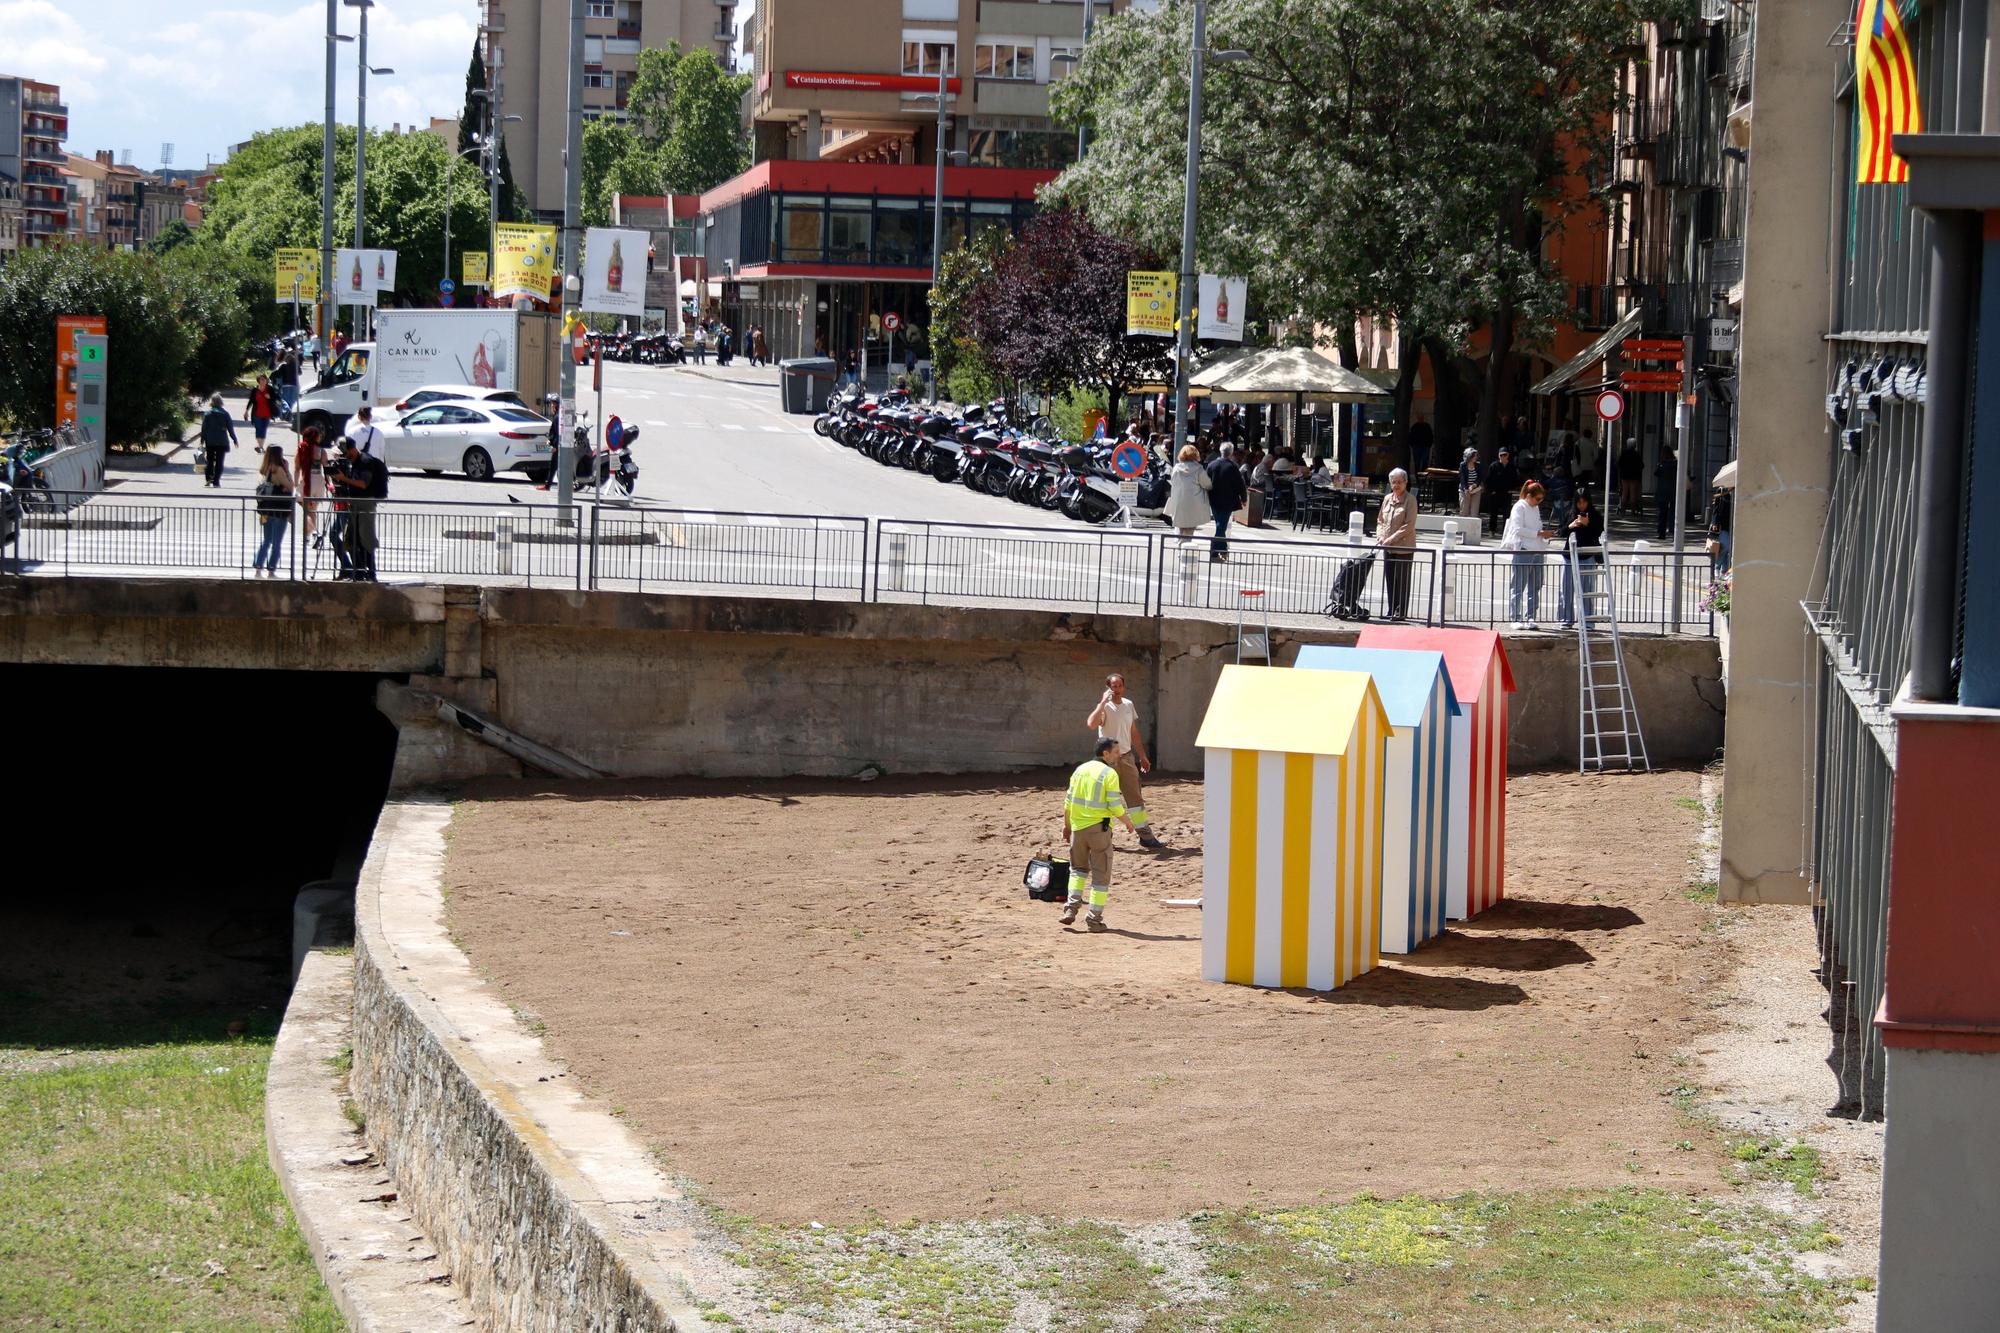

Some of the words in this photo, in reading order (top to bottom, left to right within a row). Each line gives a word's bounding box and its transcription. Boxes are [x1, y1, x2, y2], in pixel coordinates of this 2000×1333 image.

[800, 76, 827, 84] Catalana
[88, 349, 96, 359] 3
[388, 348, 409, 356] CAN
[413, 348, 437, 356] KIKU
